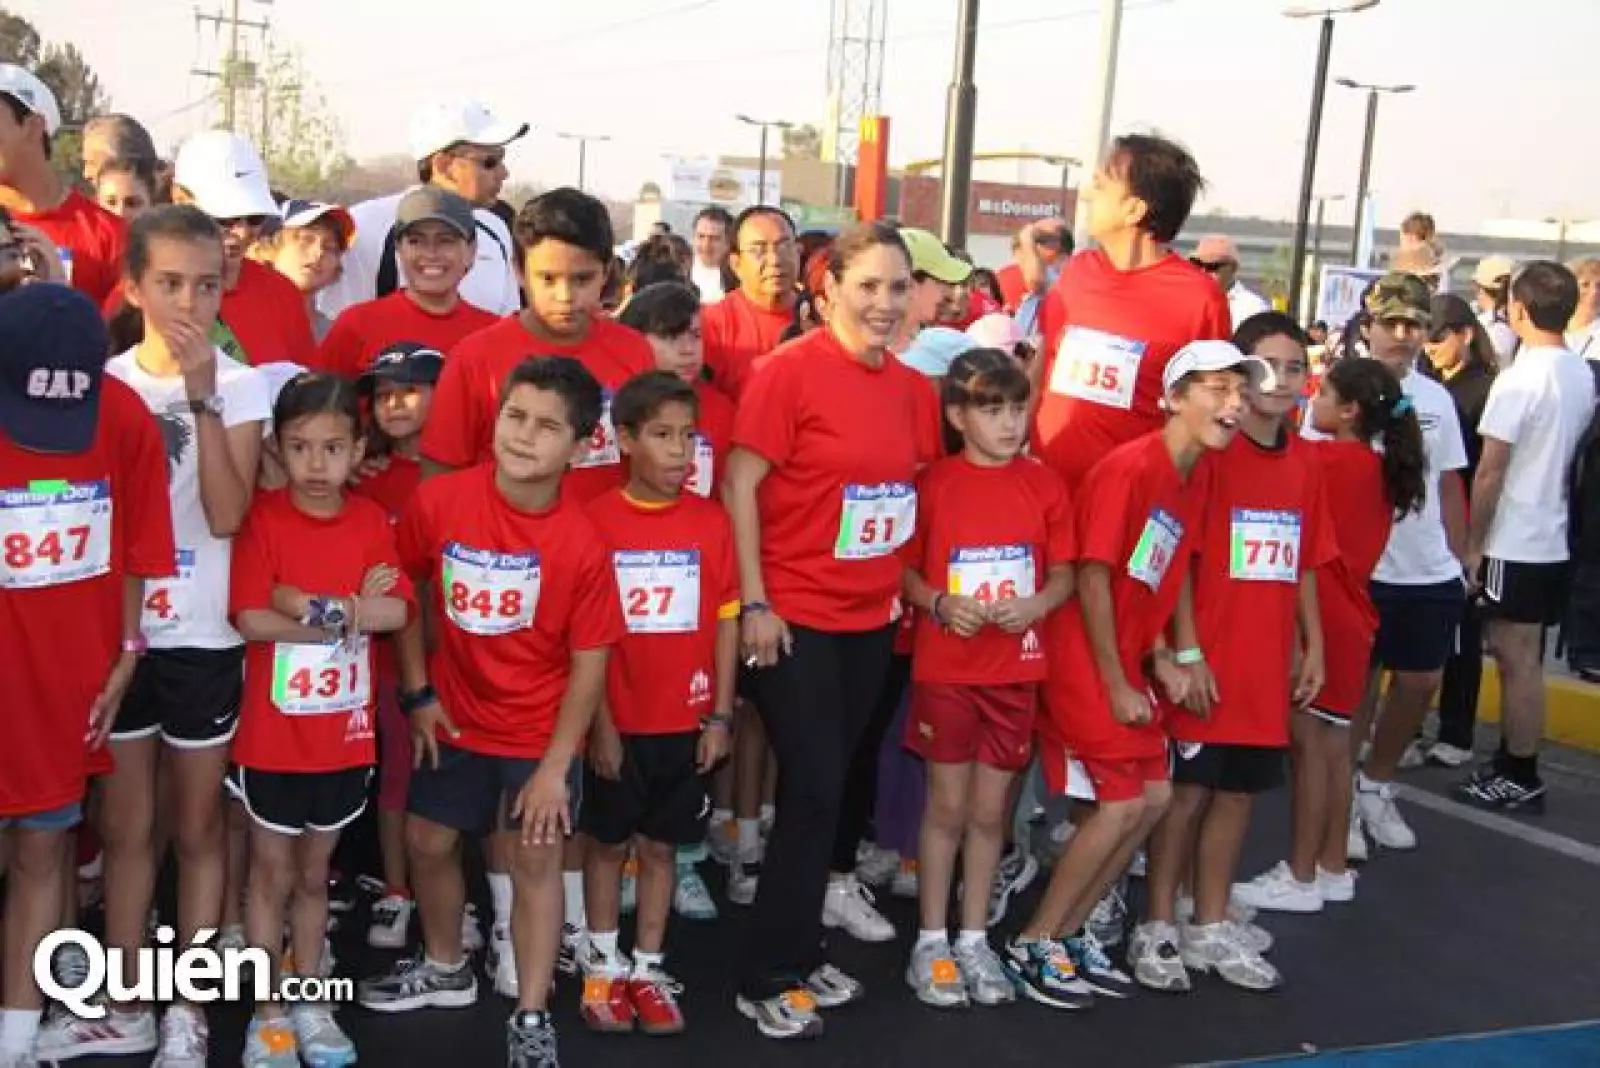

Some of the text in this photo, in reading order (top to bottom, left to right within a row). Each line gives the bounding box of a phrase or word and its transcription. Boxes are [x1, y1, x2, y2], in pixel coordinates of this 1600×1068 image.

[27, 369, 90, 399] GAP
[859, 518, 895, 544] 51
[3, 525, 91, 569] 847
[452, 543, 530, 571] Family Day
[614, 551, 691, 567] Family Day
[958, 547, 1003, 563] Family
[1244, 540, 1294, 568] 770
[451, 581, 523, 618] 848
[627, 587, 675, 616] 27
[287, 663, 359, 698] 431
